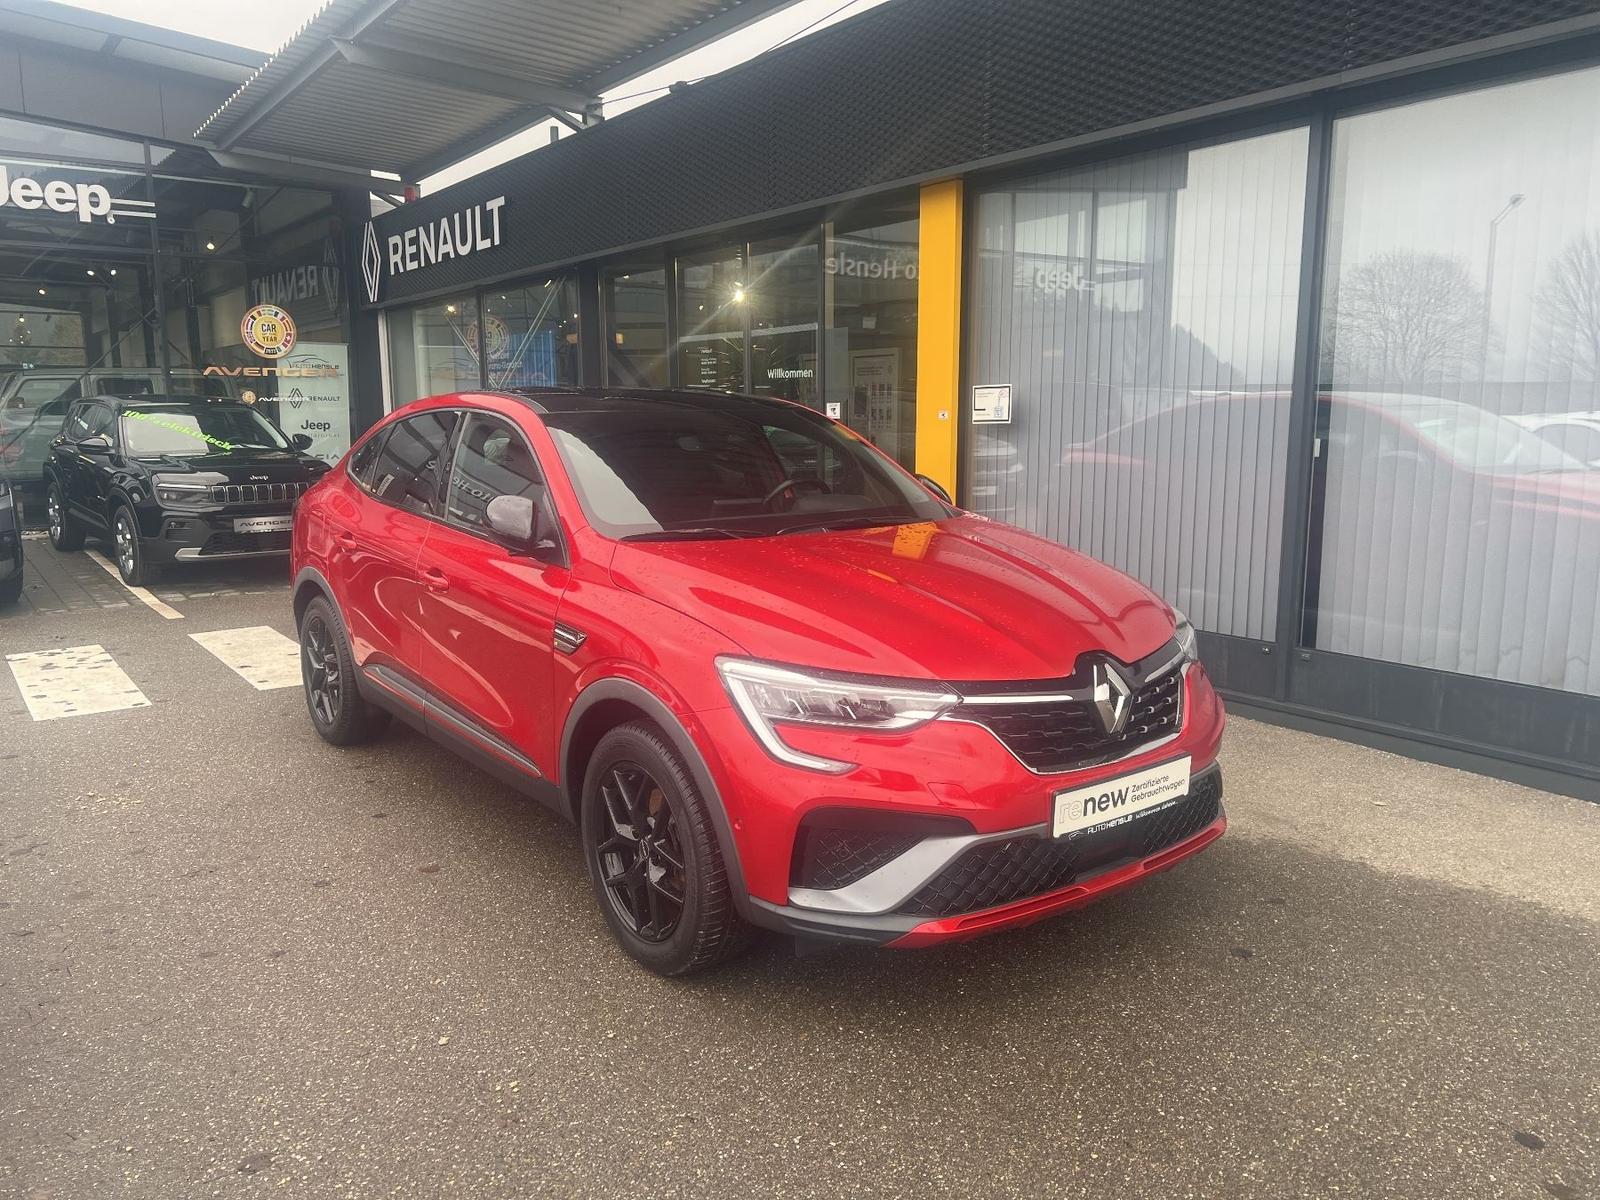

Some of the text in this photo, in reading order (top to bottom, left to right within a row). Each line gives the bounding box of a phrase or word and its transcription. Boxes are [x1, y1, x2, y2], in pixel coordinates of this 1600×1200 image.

[388, 196, 506, 276] RENAULT
[261, 324, 277, 333] CAR
[767, 368, 814, 379] Willkommen
[301, 420, 331, 432] Jeep
[1058, 774, 1170, 824] renew Zertifizierte
[1130, 778, 1186, 803] Gebrauchtwagen
